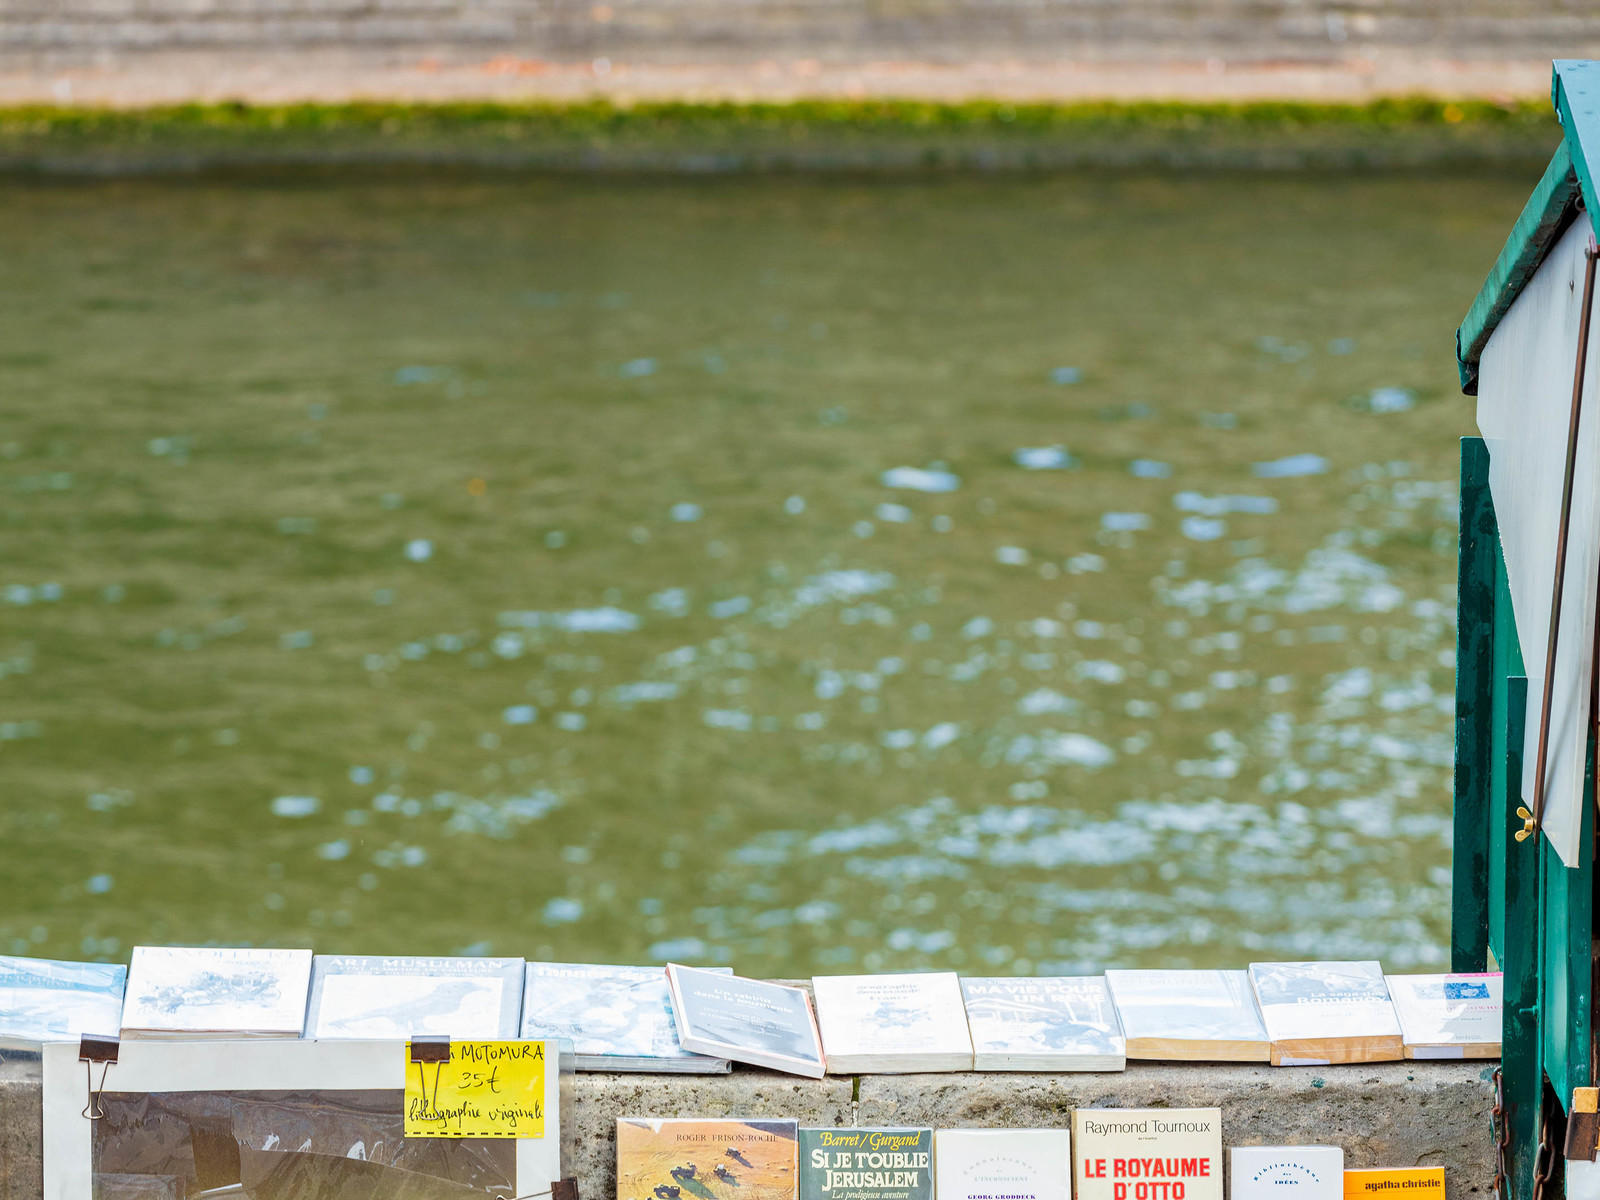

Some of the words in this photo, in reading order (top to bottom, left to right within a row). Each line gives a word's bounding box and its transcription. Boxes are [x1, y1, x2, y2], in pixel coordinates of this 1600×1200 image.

[328, 958, 371, 967] ART
[382, 959, 503, 969] MUSULMAN
[714, 988, 731, 996] Un
[734, 993, 771, 1004] rabbin
[967, 985, 1002, 995] MA
[1005, 985, 1038, 994] VIE
[1044, 985, 1104, 994] POUR
[1013, 994, 1045, 1003] UN
[694, 990, 720, 1000] dans
[736, 998, 794, 1014] tourmente
[461, 1044, 544, 1064] MOTOMURA
[458, 1066, 501, 1094] 35€
[1085, 1120, 1147, 1136] Raymond
[1151, 1119, 1211, 1133] Tournoux
[676, 1134, 707, 1142] ROGER
[712, 1134, 779, 1142] FRISON-ROCHE
[820, 1131, 858, 1147] Barret
[869, 1130, 921, 1151] Gurgand
[833, 1152, 852, 1169] JE
[854, 1152, 929, 1169] T'OUBLIE
[1084, 1158, 1106, 1178] LE
[1113, 1157, 1211, 1178] ROYAUME
[821, 1169, 919, 1192] JERUSALEM
[1253, 1162, 1320, 1182] Bibliothèque
[1113, 1181, 1185, 1200] D'OTTO
[1365, 1180, 1400, 1192] agatha
[1402, 1178, 1441, 1189] christie
[832, 1190, 844, 1199] La
[881, 1190, 910, 1199] aventure
